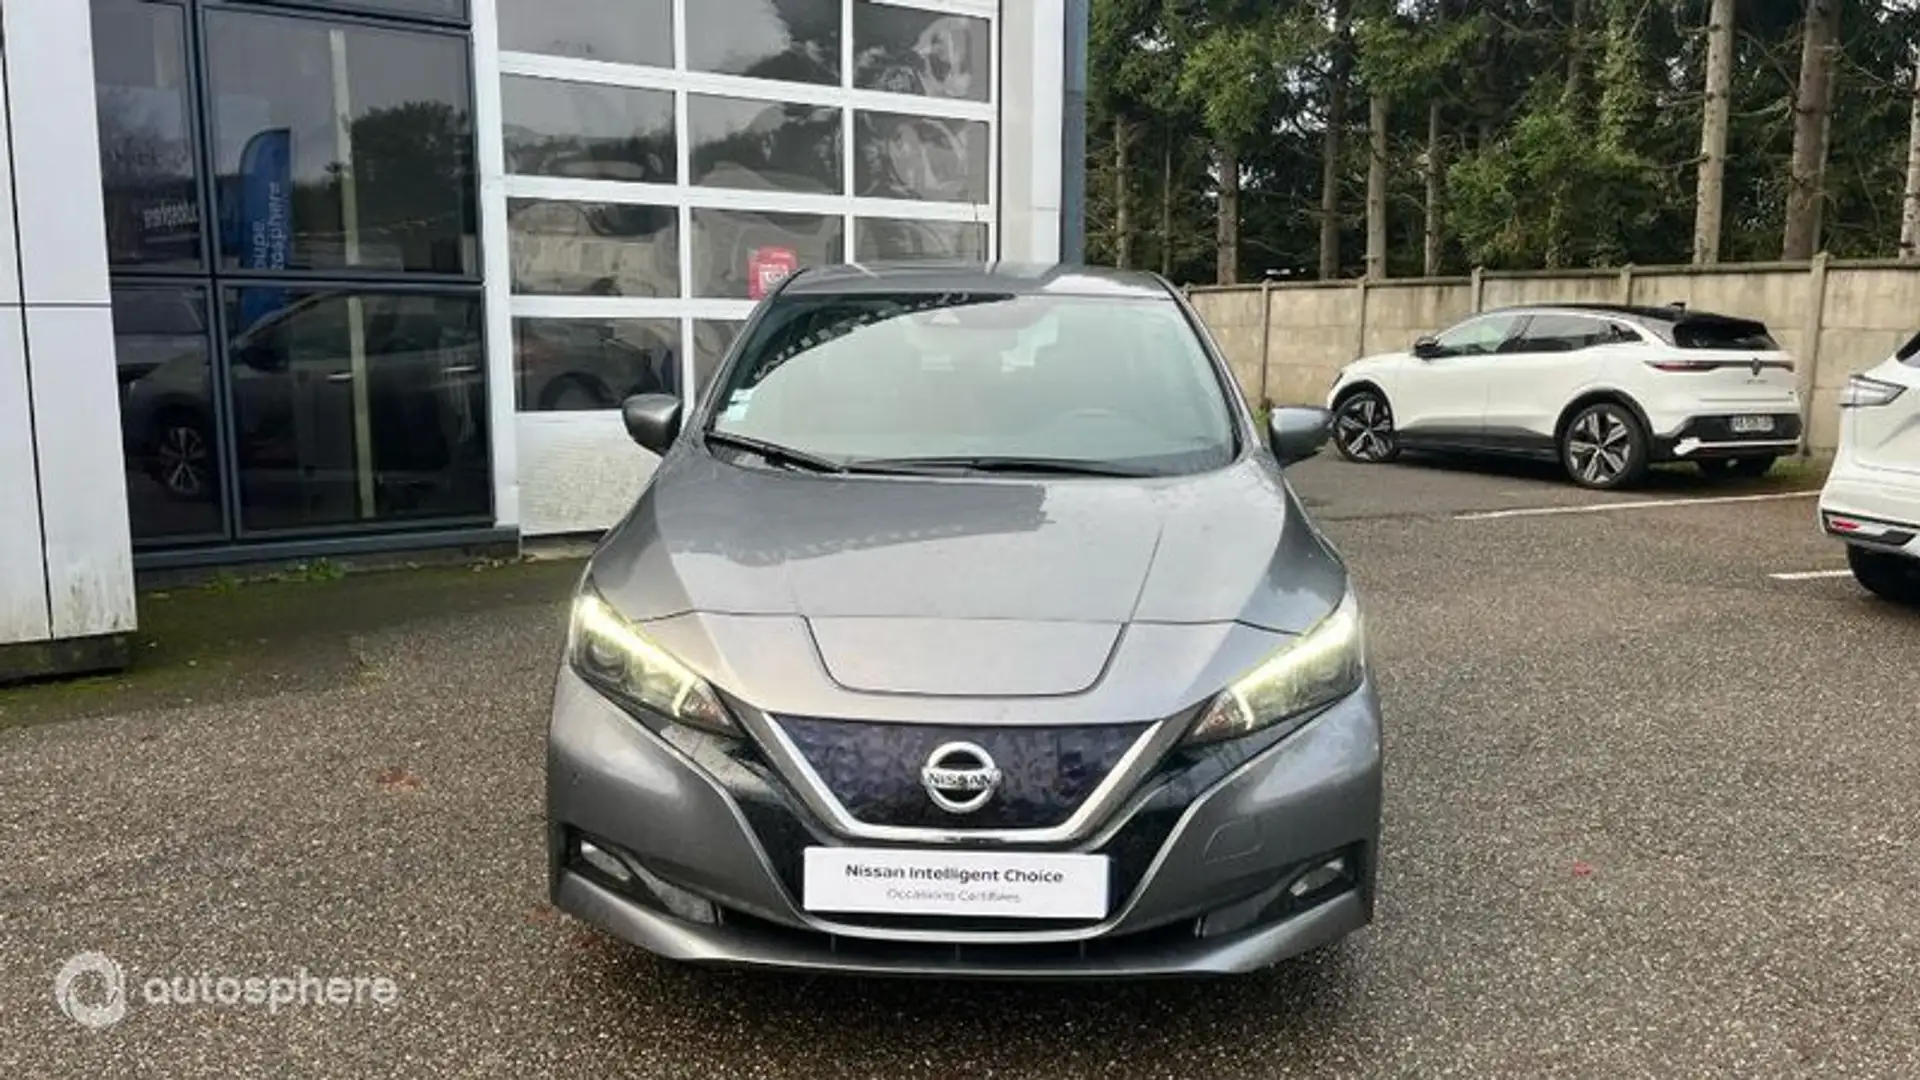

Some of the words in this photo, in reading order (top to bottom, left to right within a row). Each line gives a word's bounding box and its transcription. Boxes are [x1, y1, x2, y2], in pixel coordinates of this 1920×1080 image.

[927, 773, 992, 786] NISSAN
[844, 864, 905, 879] Nissan
[909, 866, 998, 884] Intelligent
[1003, 868, 1064, 883] Choice
[886, 887, 956, 901] Occasions
